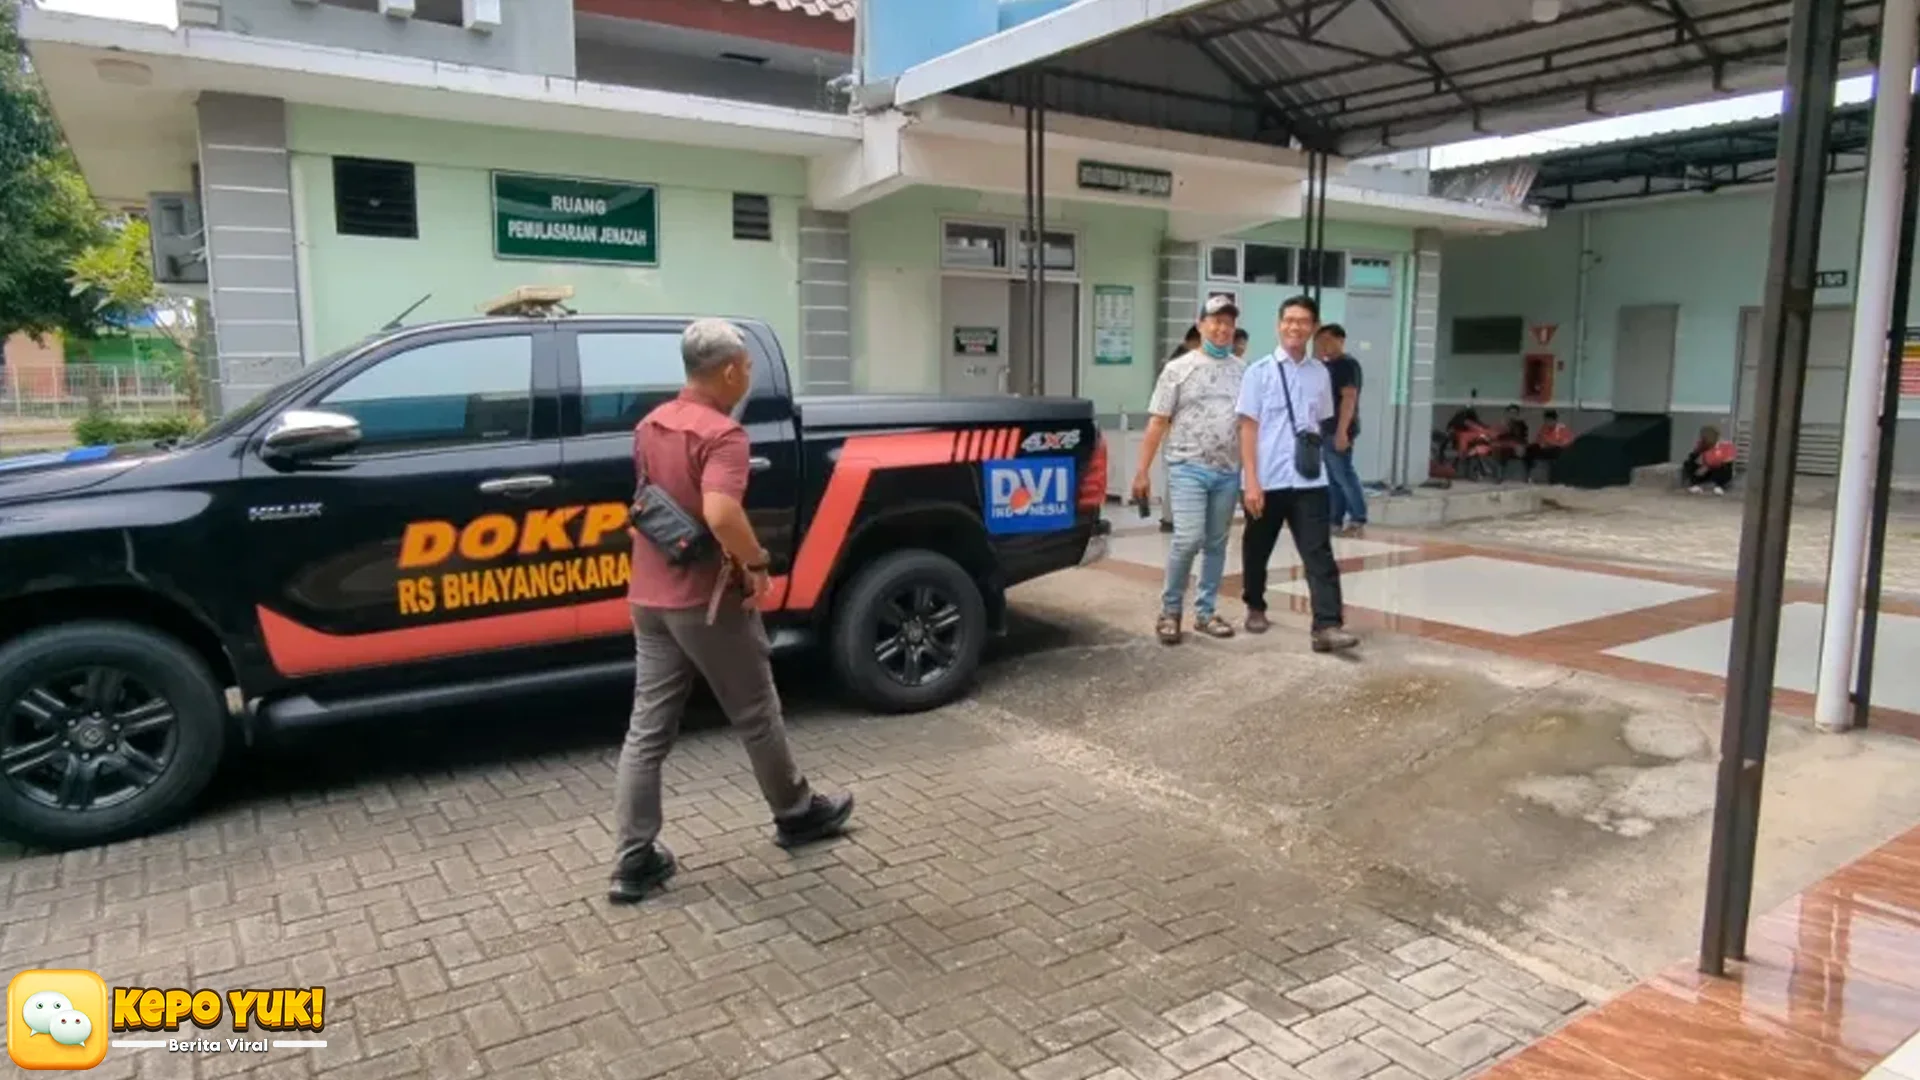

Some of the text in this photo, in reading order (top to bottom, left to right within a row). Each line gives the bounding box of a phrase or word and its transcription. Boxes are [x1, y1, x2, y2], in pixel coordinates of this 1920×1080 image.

[551, 195, 607, 215] RUANG
[508, 219, 648, 246] PEMULASARAAN JENAZAH
[991, 466, 1068, 505] DVI
[398, 501, 634, 569] DOKP
[398, 552, 632, 615] RS BHAYANGKARA
